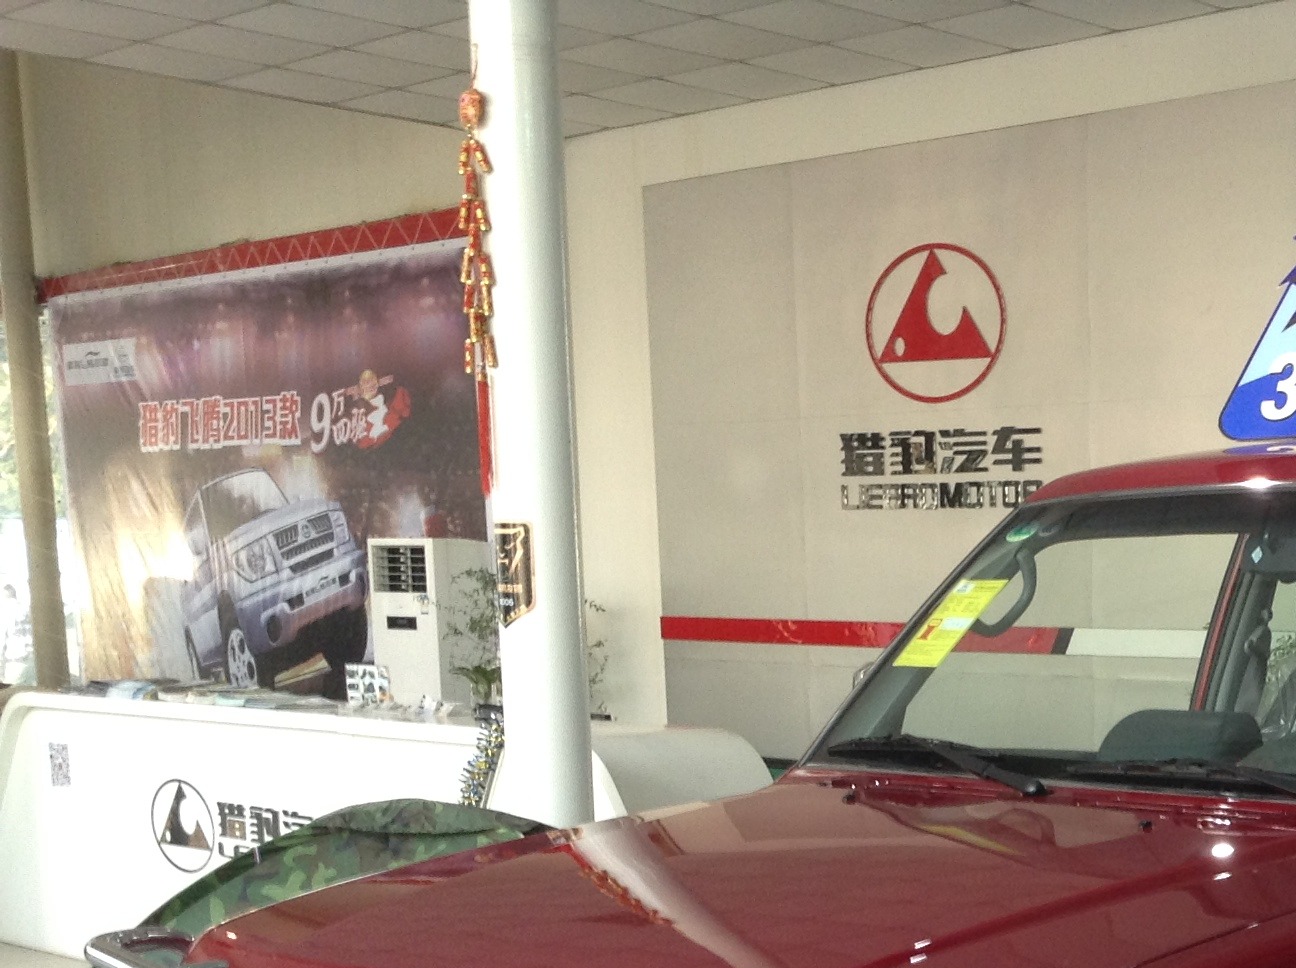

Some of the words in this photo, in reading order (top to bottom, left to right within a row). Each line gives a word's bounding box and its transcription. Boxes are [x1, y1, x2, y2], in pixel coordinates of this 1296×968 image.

[139, 391, 301, 453] 猎豹飞腾2013款
[839, 426, 1043, 477] 猎豹汽车
